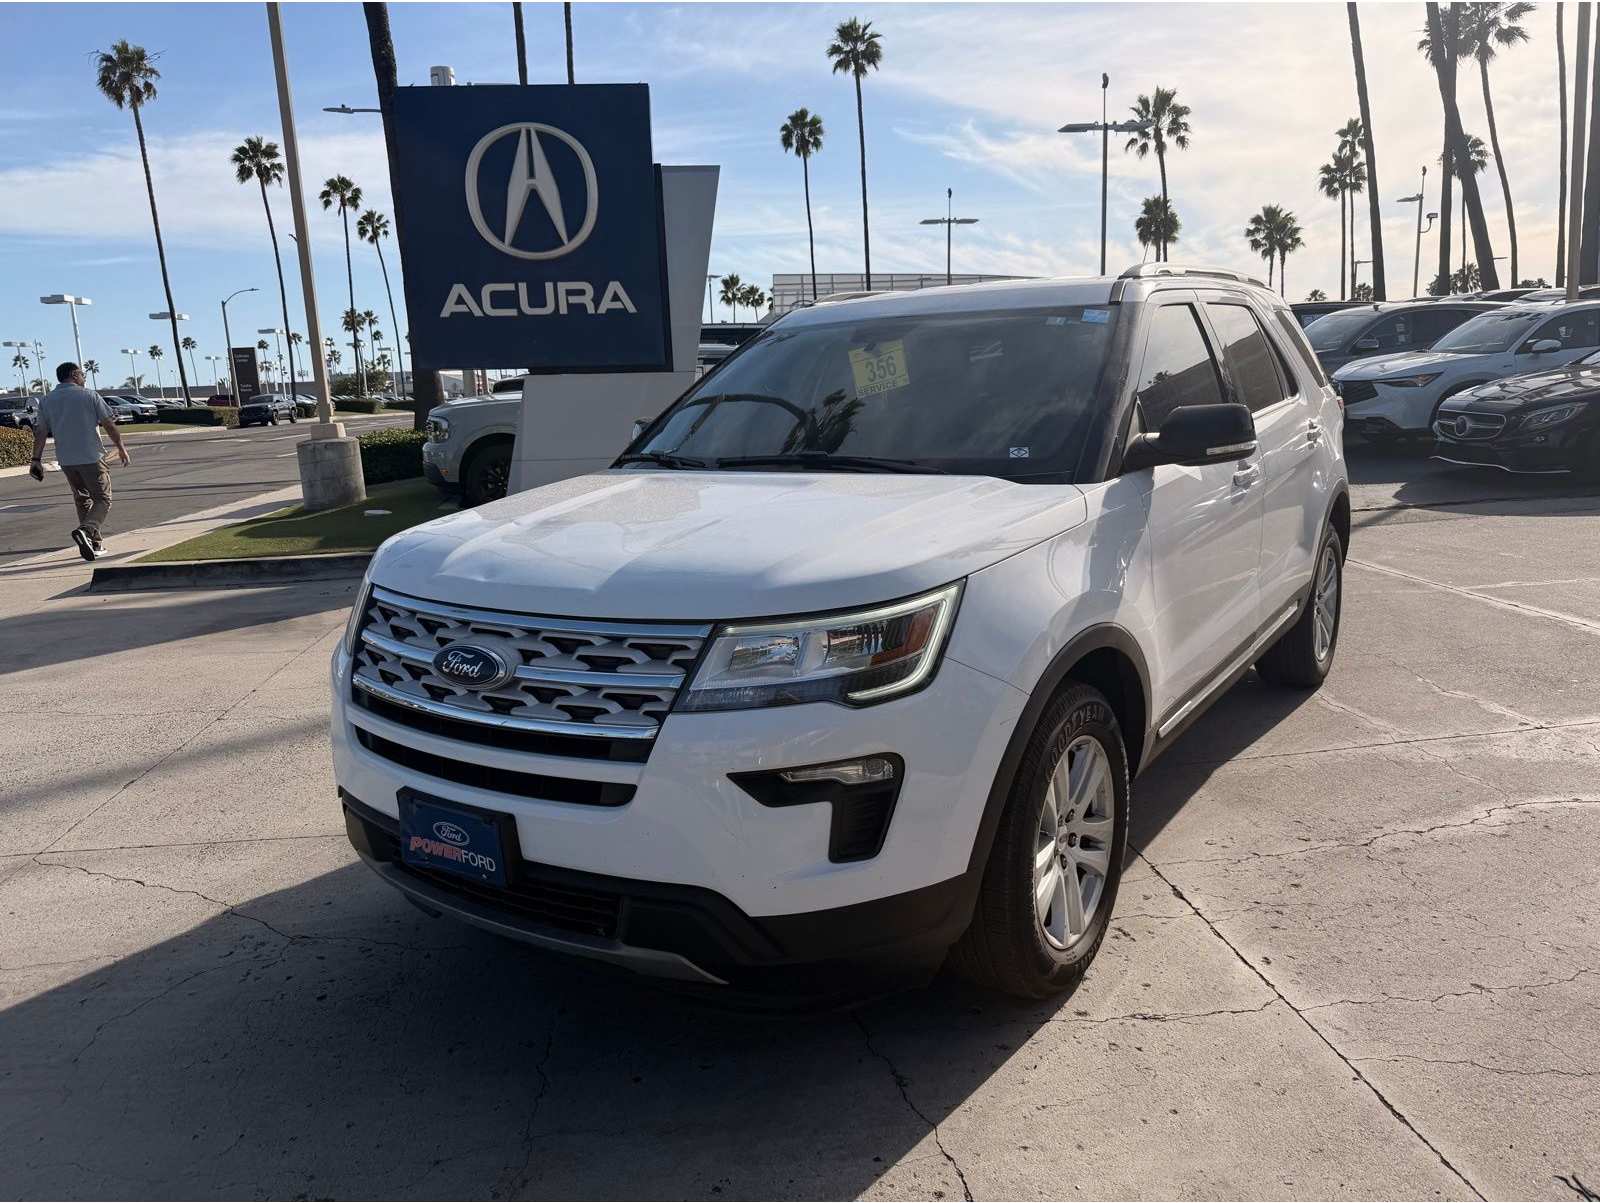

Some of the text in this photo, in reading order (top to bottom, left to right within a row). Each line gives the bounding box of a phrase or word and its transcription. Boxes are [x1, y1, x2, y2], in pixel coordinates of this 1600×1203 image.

[440, 280, 638, 318] ACURA
[865, 355, 897, 382] 356
[857, 380, 898, 394] SERVICE
[442, 650, 483, 678] Ford
